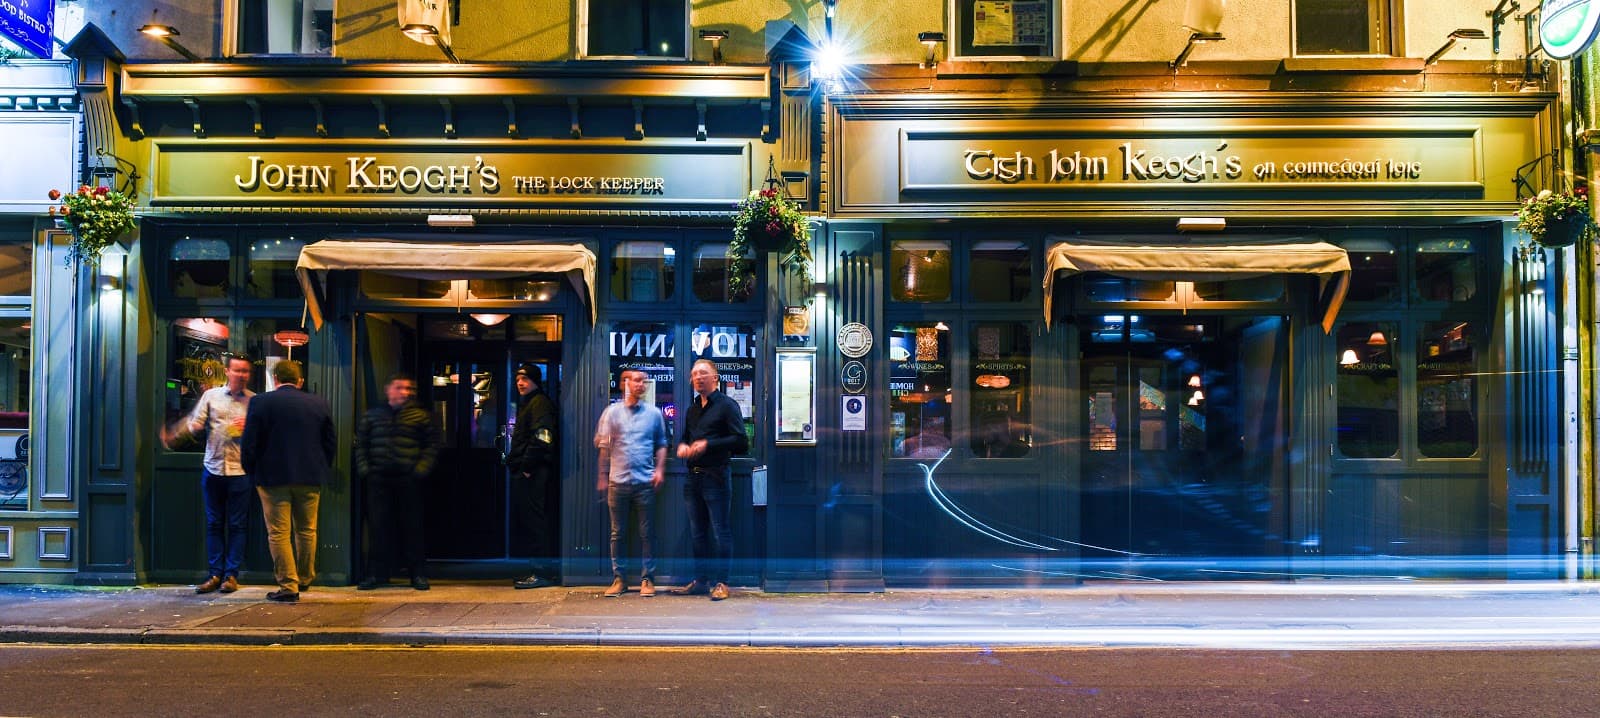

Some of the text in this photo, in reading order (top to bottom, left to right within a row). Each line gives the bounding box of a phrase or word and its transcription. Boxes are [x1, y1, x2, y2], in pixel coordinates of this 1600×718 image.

[18, 9, 46, 34] BISTRO
[234, 155, 665, 190] JOHN KEOGH'S THE LOCK KEEPER
[1049, 150, 1108, 181] John
